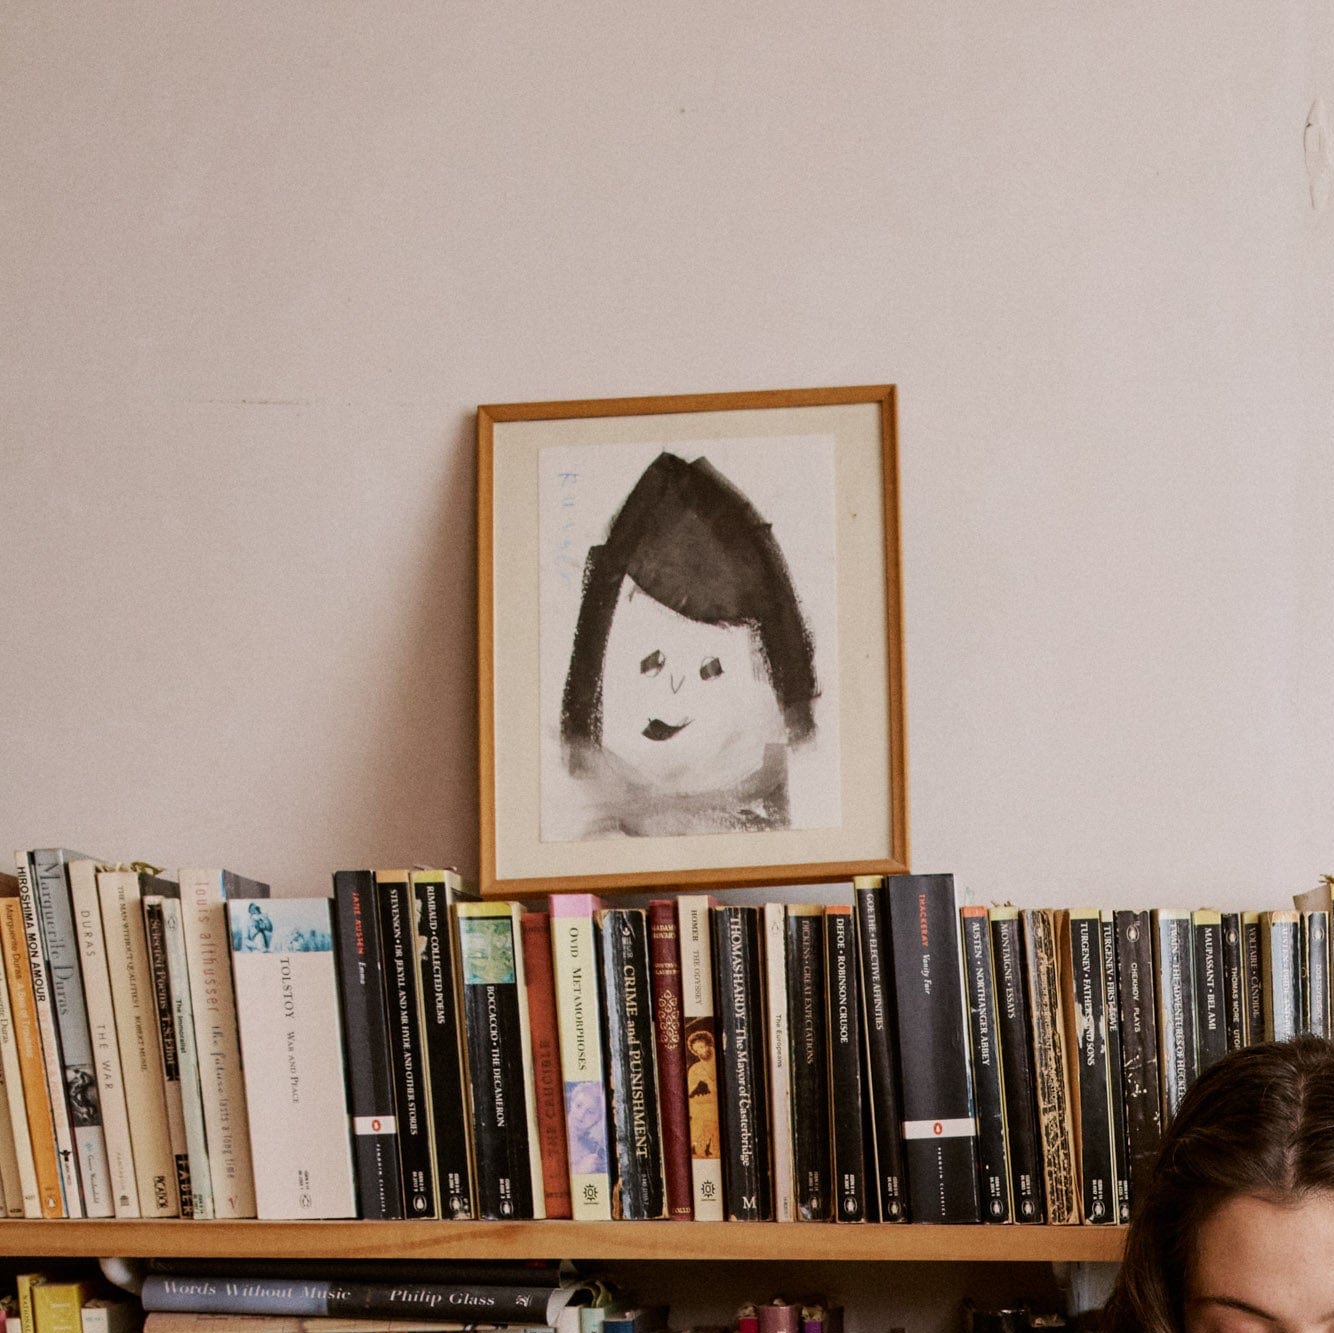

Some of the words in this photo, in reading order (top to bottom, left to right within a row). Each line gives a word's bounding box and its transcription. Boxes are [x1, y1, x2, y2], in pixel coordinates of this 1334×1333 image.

[17, 866, 34, 929] HIROSHIMA
[426, 886, 437, 930] RIMBAUD
[26, 933, 40, 959] MON
[972, 922, 982, 959] AUSTEN
[31, 962, 46, 1002] AMOUR
[431, 936, 442, 991] COLLECTED
[436, 993, 445, 1024] POEMS
[623, 965, 636, 1016] CRIME
[975, 967, 988, 1034] NORTHANGER
[626, 1020, 640, 1044] and
[980, 1036, 990, 1066] ABBEY
[629, 1050, 648, 1159] PUNISHMENT
[164, 1281, 216, 1297] Words
[225, 1283, 293, 1299] Without
[300, 1285, 351, 1301] Music
[389, 1289, 442, 1308] Philip
[449, 1292, 495, 1306] Glass
